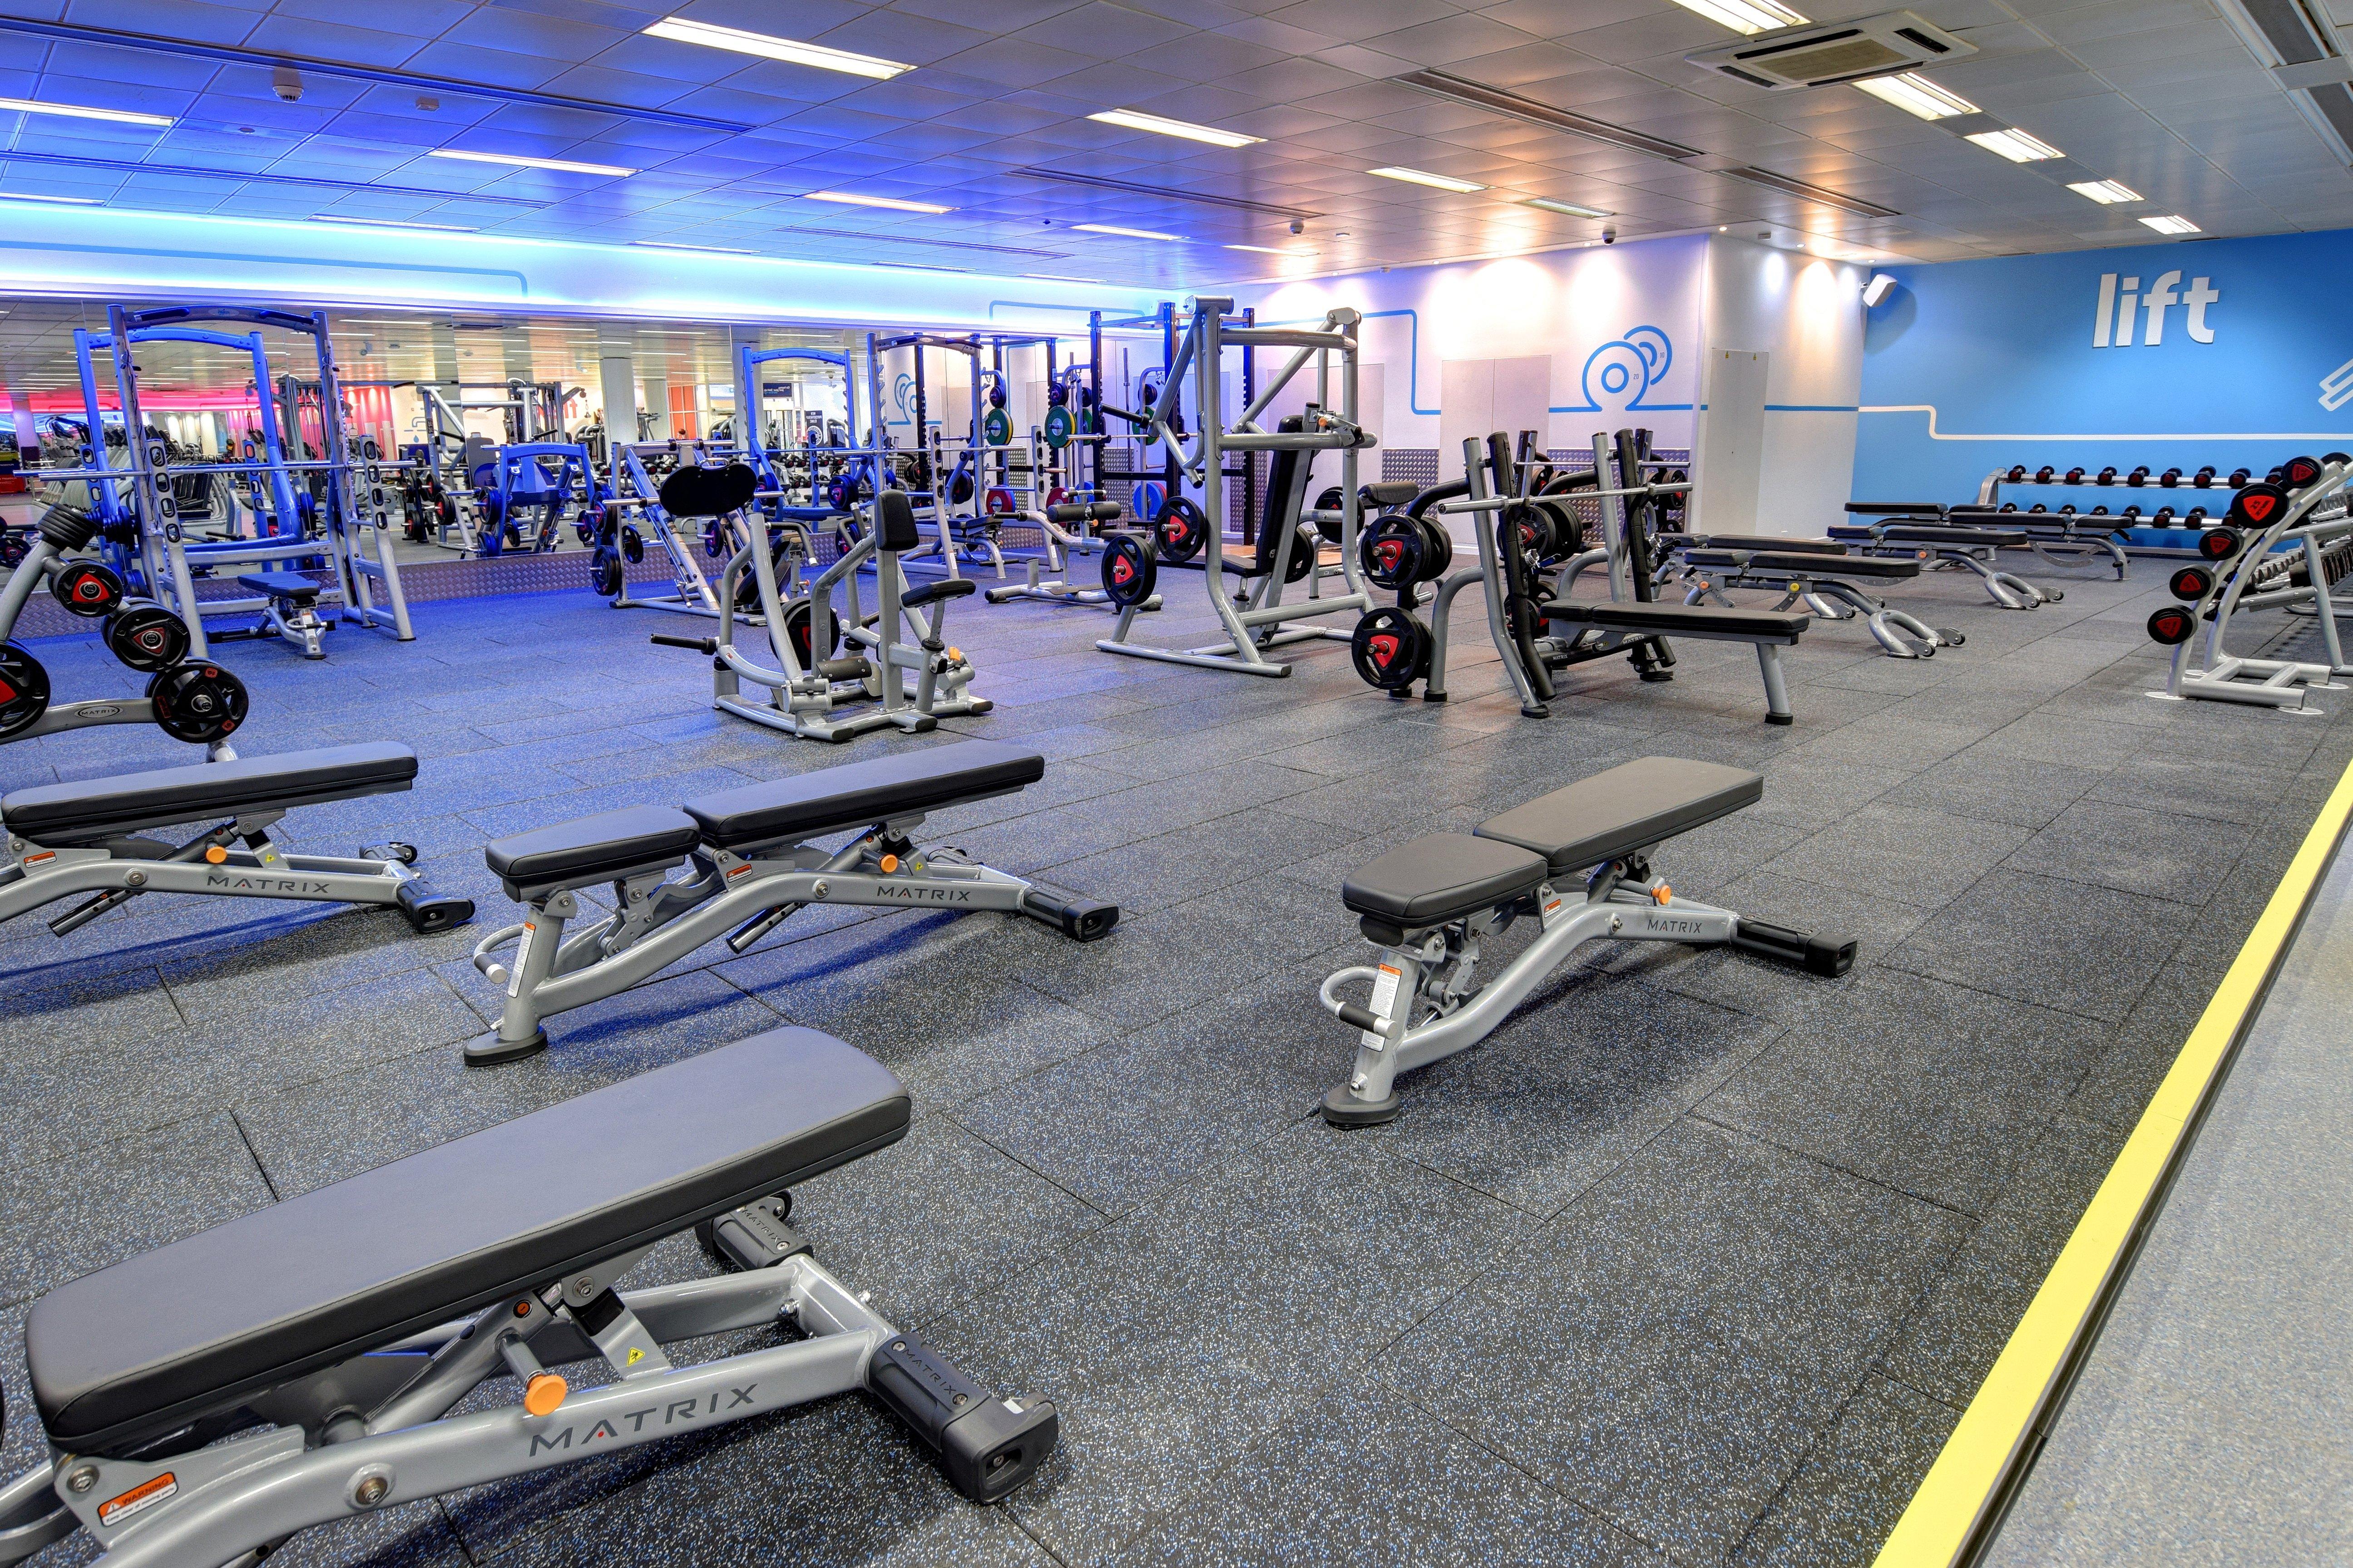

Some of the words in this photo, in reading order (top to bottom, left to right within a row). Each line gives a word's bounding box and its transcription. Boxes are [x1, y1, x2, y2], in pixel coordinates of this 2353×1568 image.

[2092, 270, 2219, 348] lift
[1621, 635, 1645, 645] MATRIX
[207, 876, 330, 893] MATRIX
[877, 886, 971, 901] MATRIX
[1647, 919, 1702, 933] MATRIX
[741, 1209, 781, 1243] MATRIX
[902, 1349, 956, 1395] MATRIX
[529, 1383, 758, 1458] MATRIX
[122, 1478, 169, 1505] WARNING
